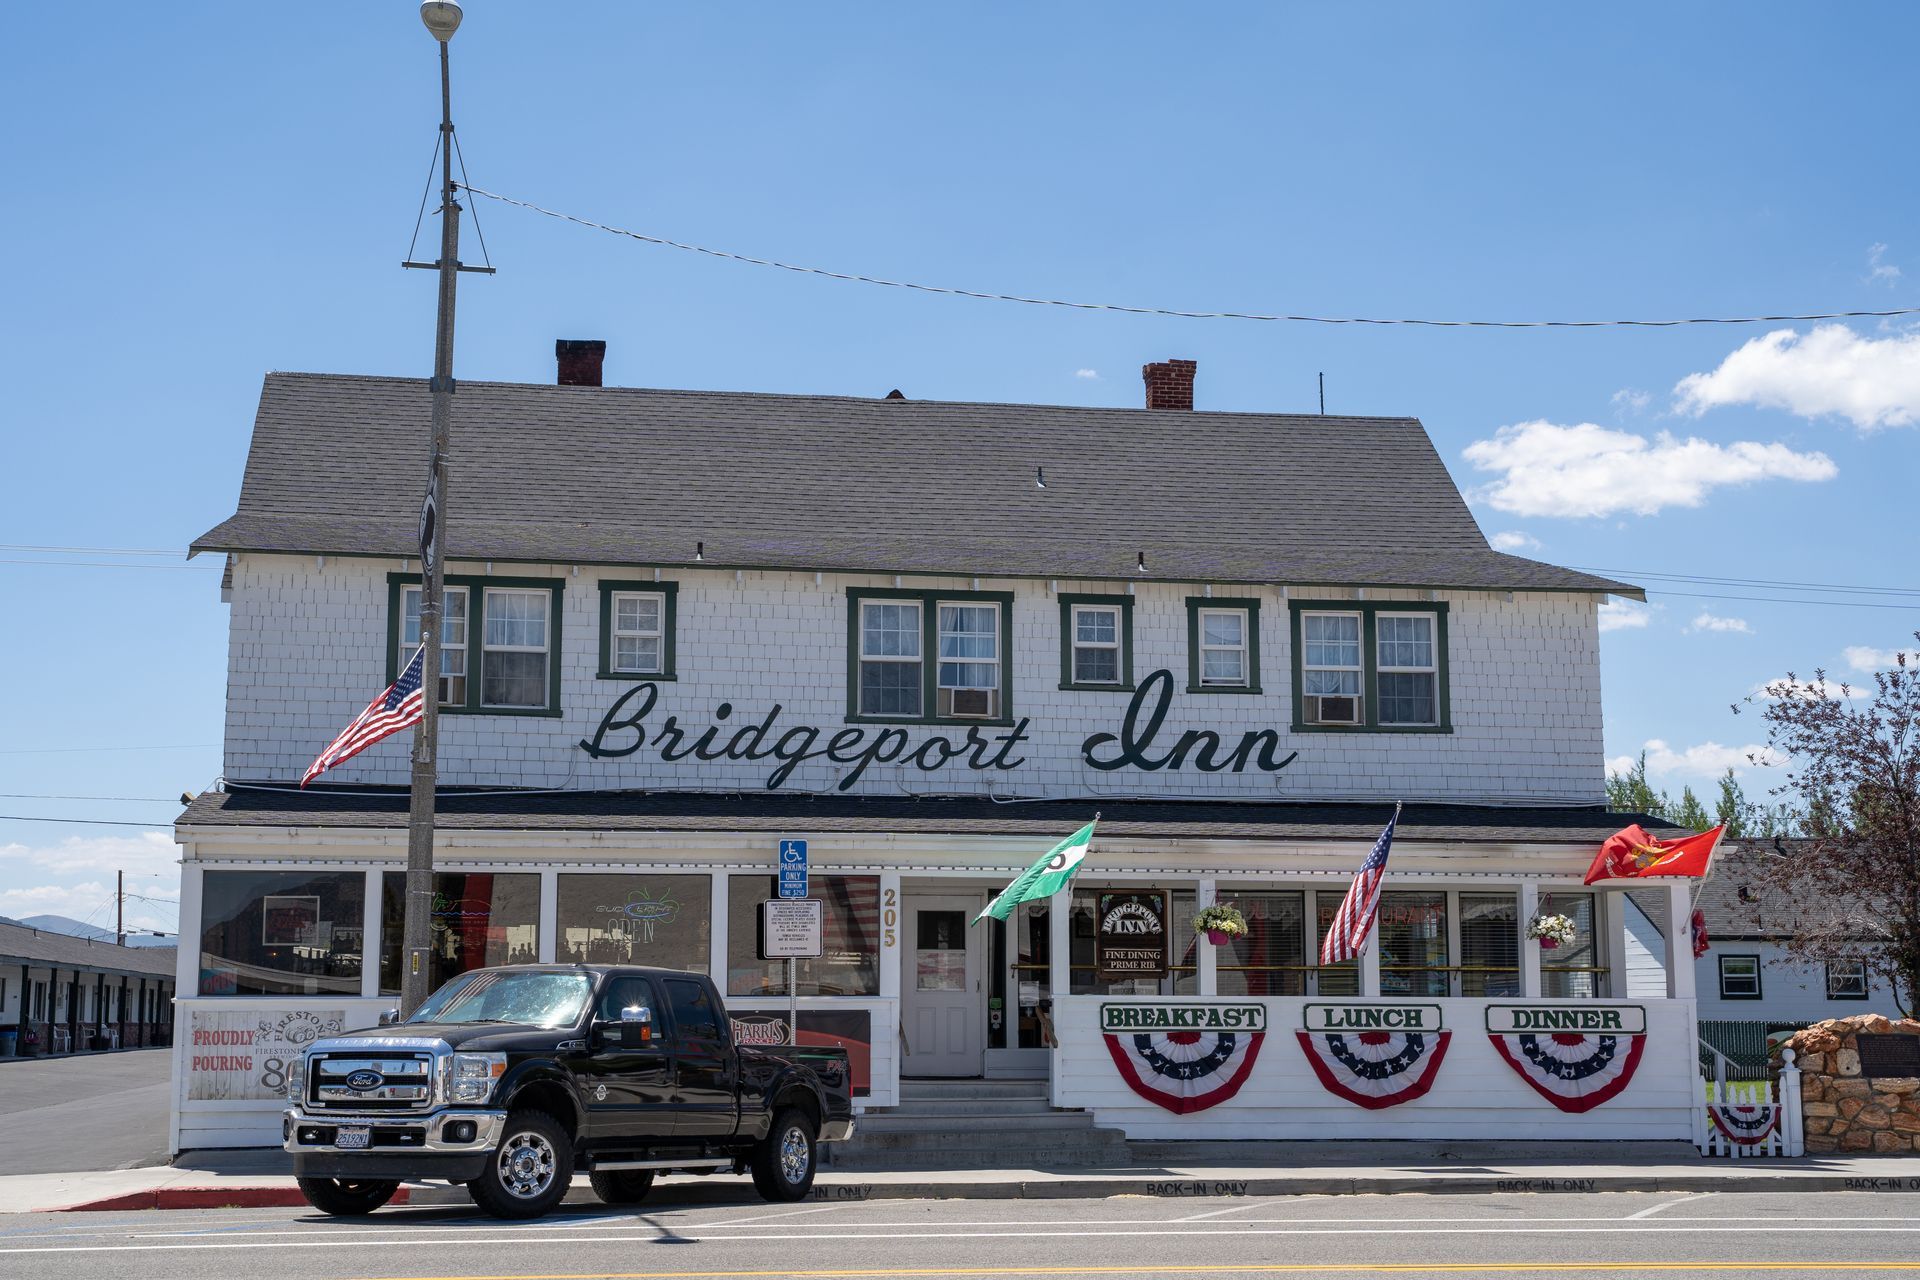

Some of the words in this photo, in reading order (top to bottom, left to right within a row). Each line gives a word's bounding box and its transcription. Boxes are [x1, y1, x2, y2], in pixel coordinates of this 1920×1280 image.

[579, 682, 1030, 791] Bridgeport
[1081, 669, 1298, 772] Inn
[781, 862, 807, 871] PARKING
[785, 872, 801, 881] ONLY
[884, 888, 897, 948] 205
[1101, 902, 1163, 934] BRIDGEPORT
[607, 918, 656, 944] OPEN
[1113, 919, 1150, 934] INN
[1105, 951, 1127, 960] FINE
[1128, 951, 1161, 960] DINING
[1110, 961, 1140, 969] PRIME
[1140, 961, 1156, 969] RIB
[1105, 1007, 1262, 1028] BREAKFAST
[1323, 1008, 1424, 1028] LUNCH
[1511, 1009, 1623, 1029] DINNER
[274, 1010, 326, 1042] FIRESTON
[731, 1018, 784, 1046] HARRIS
[193, 1030, 256, 1046] PROUDLY
[192, 1055, 253, 1072] POURING
[352, 1074, 373, 1085] Ford
[1146, 1182, 1207, 1195] BACK-IN
[1215, 1182, 1248, 1195] ONLY
[1497, 1180, 1555, 1192] BACK-IN
[1563, 1179, 1595, 1191] ONLY
[1845, 1178, 1902, 1190] BACK-IN
